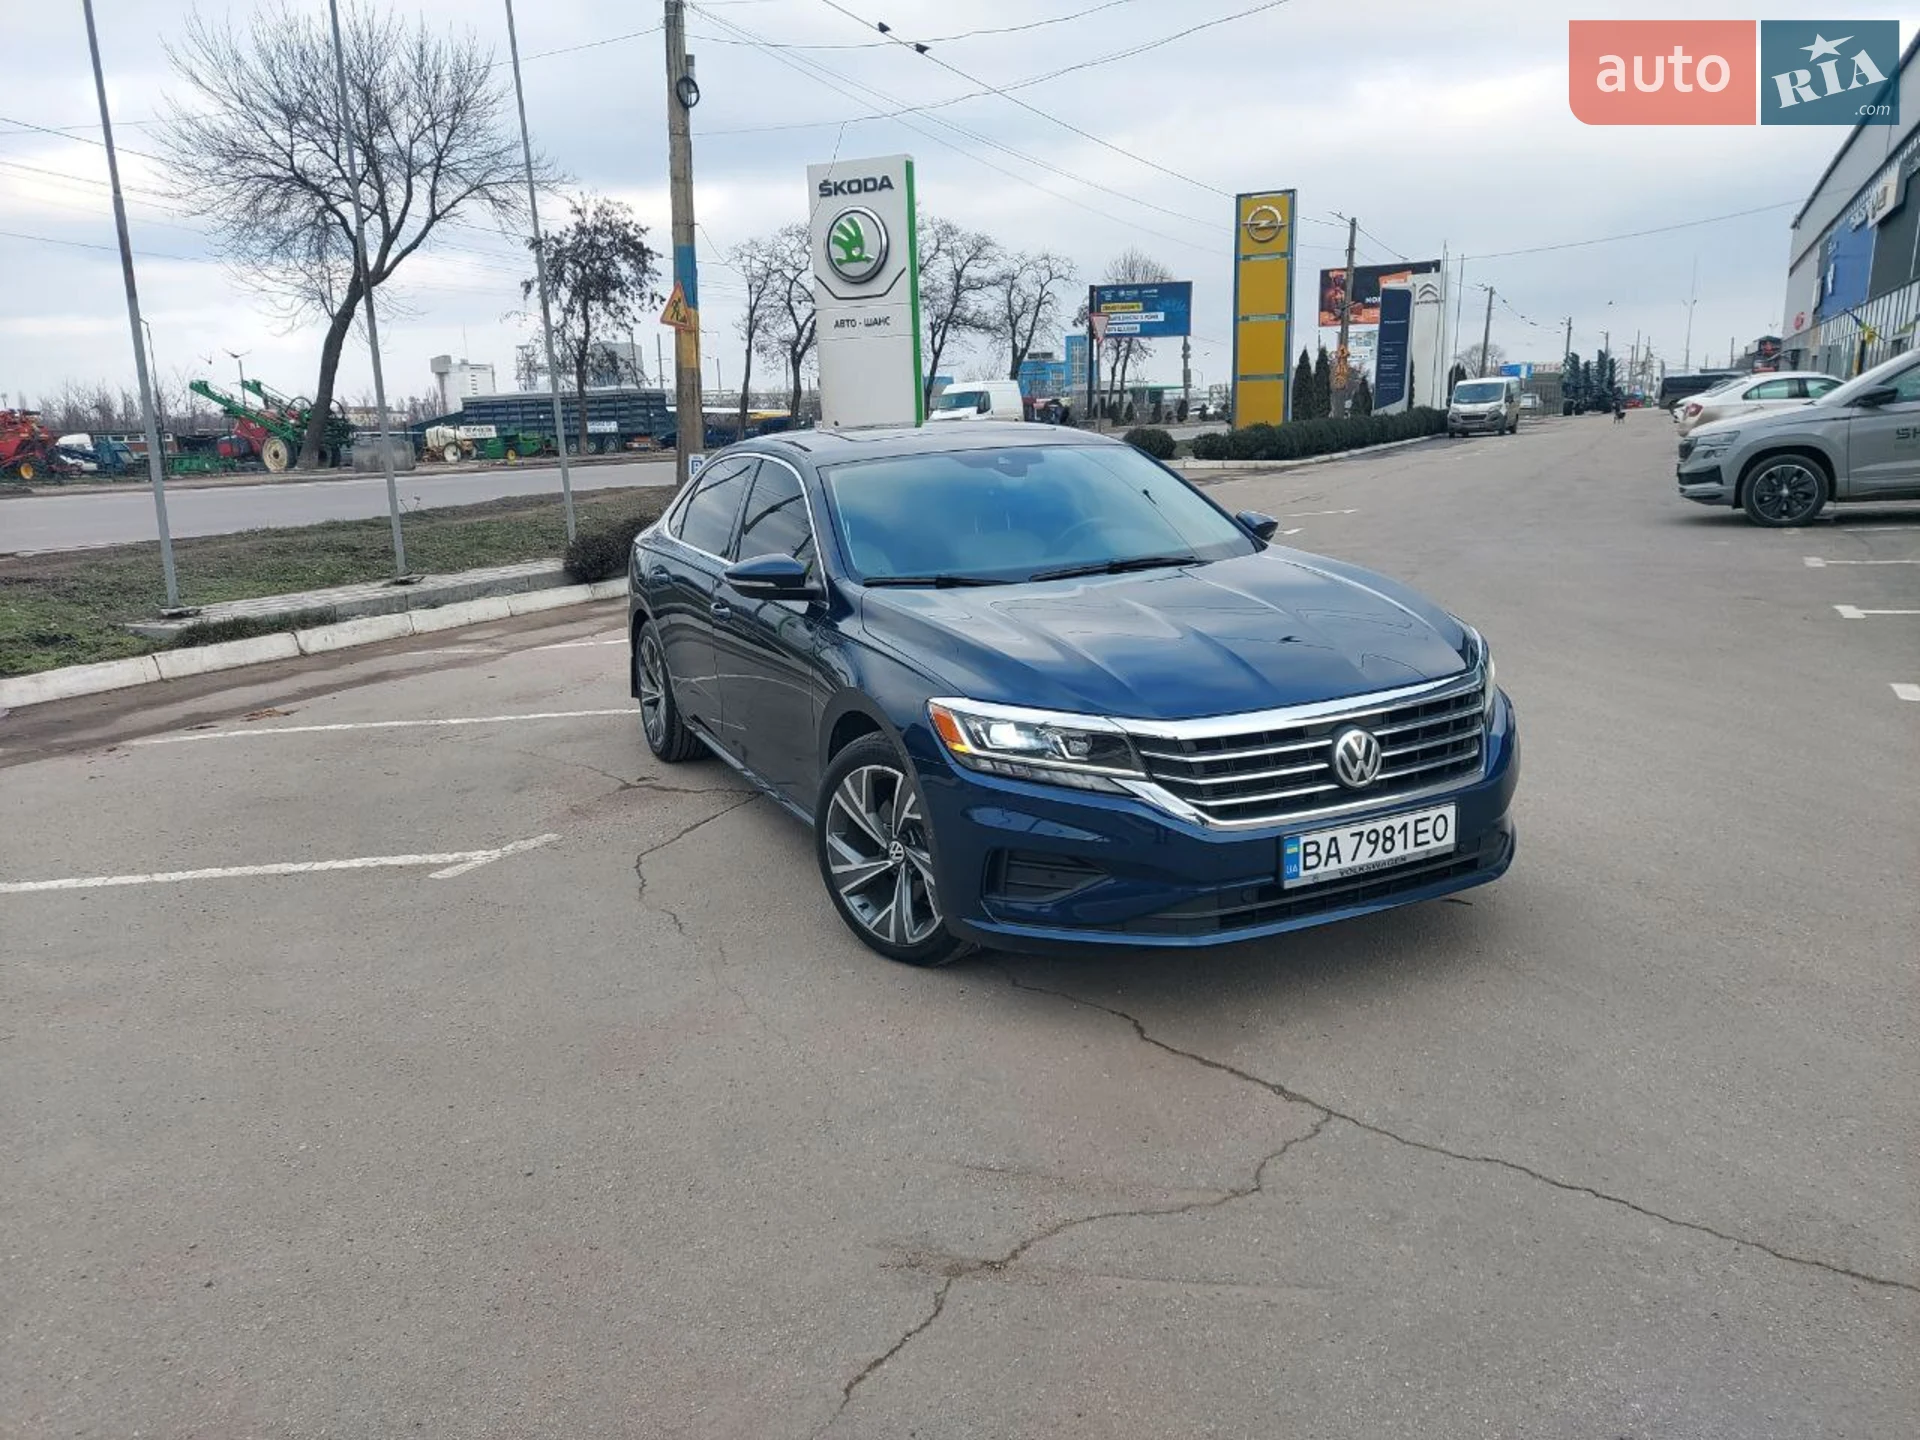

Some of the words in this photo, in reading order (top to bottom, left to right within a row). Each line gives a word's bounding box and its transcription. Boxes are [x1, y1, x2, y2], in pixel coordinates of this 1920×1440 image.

[818, 175, 894, 198] ŠKODA
[834, 318, 857, 329] АВТО
[863, 316, 891, 327] ШАНС
[1286, 864, 1298, 875] UA
